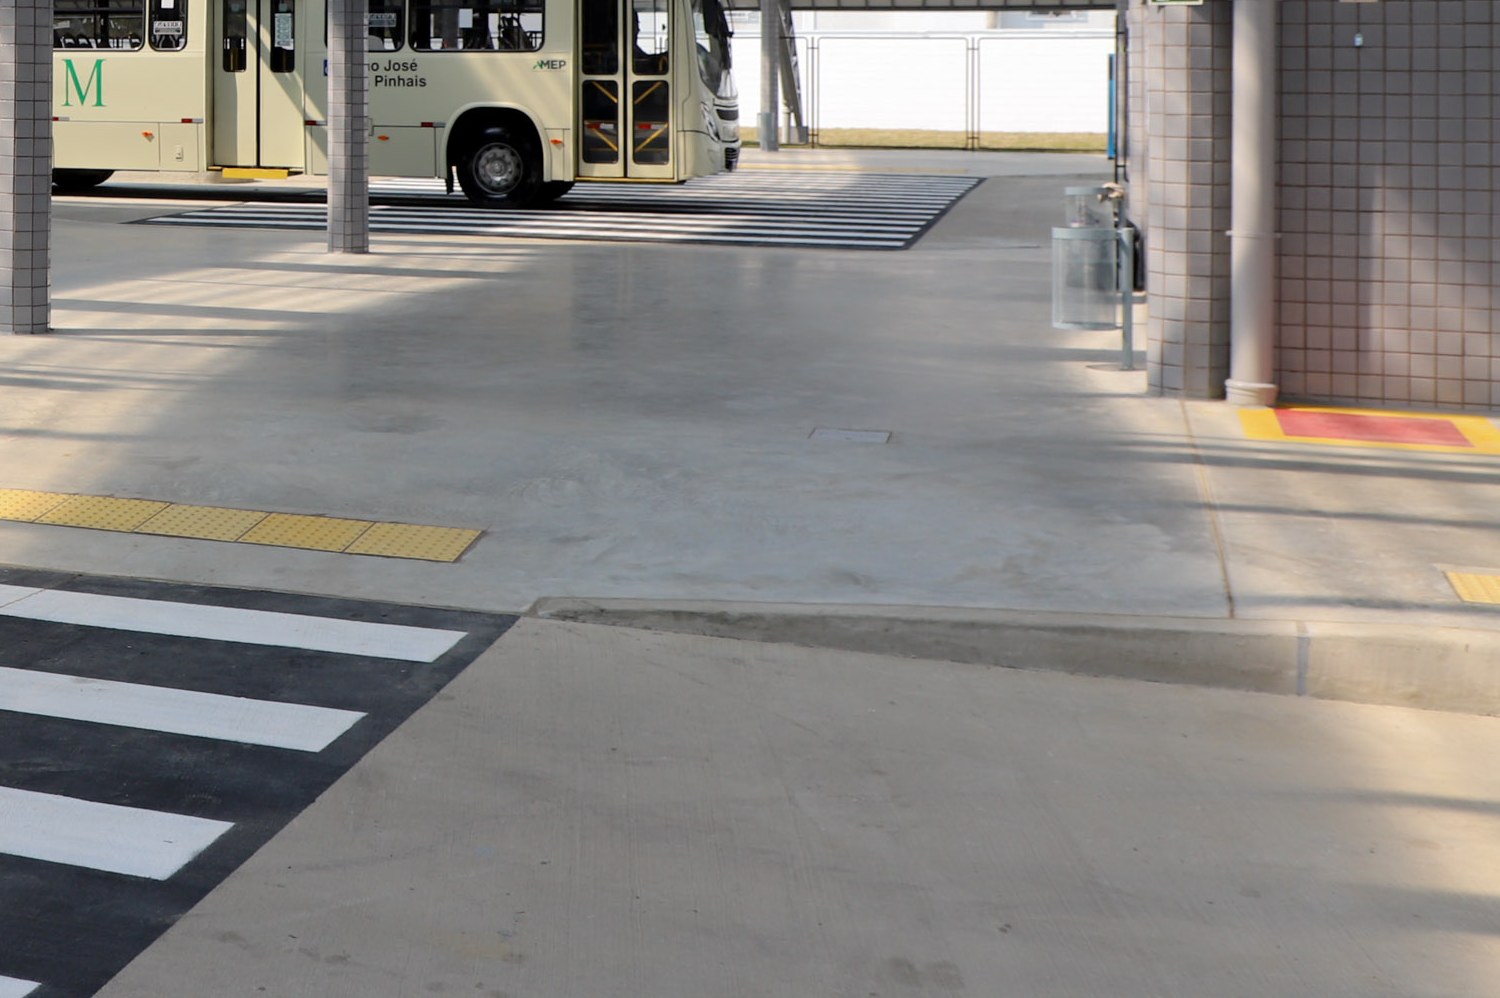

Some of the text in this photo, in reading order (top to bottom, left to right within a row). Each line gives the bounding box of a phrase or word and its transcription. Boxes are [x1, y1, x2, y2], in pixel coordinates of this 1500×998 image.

[383, 58, 418, 72] José
[61, 59, 107, 107] M
[374, 75, 427, 87] Pinhais
